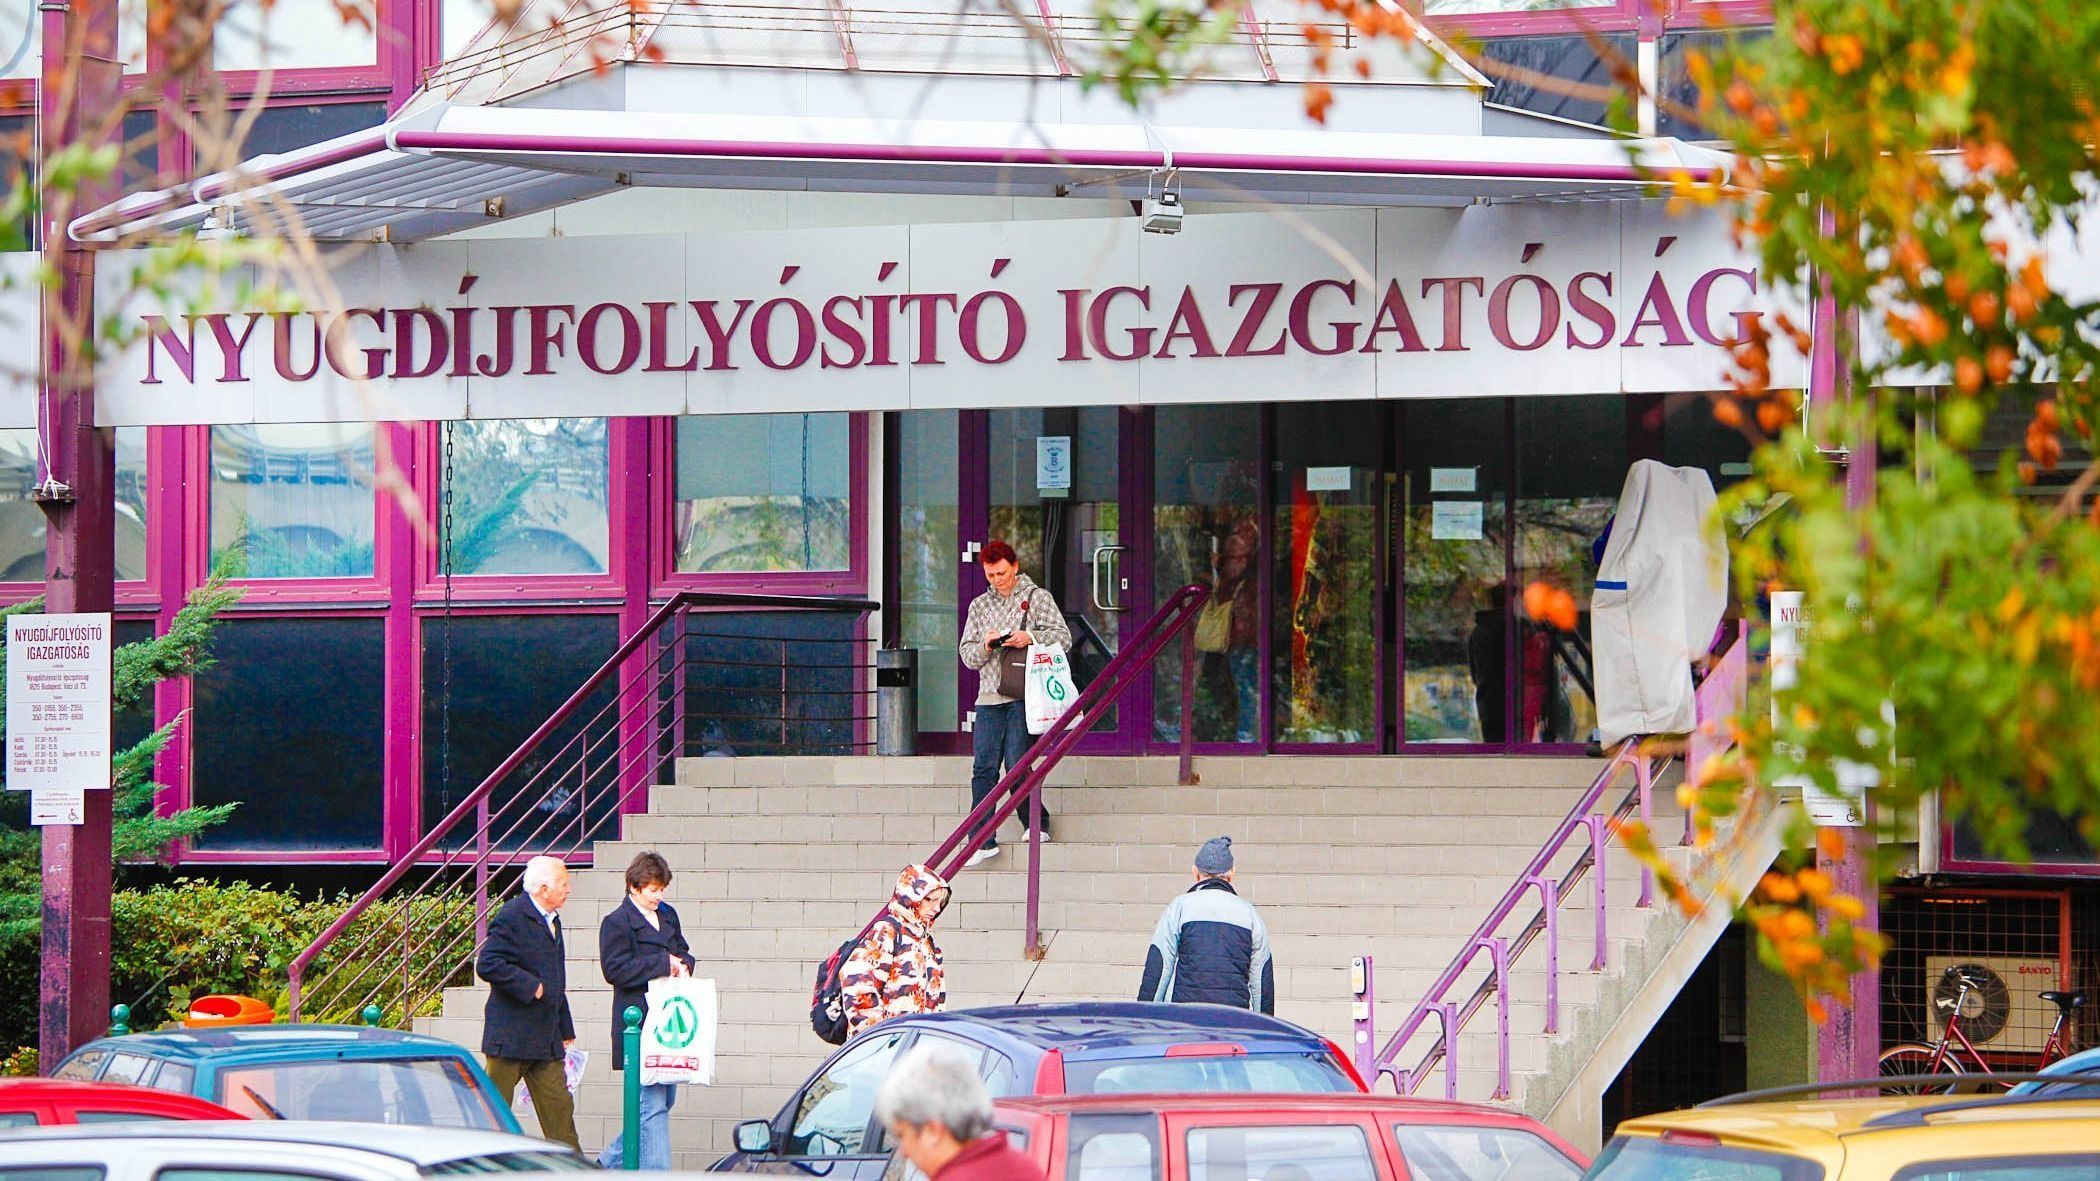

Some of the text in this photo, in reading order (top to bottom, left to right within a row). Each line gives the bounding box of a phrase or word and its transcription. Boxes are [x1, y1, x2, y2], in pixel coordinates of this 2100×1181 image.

[140, 235, 1764, 384] NYUGDÍJFOLYÓSÍTÓ IGAZGATÓSÁG
[15, 624, 102, 642] NYUGDÍJFOLYÓSÍTÓ
[27, 642, 90, 660] IGAZGATÓSÁG
[2018, 966, 2052, 975] SANYO
[644, 1054, 700, 1071] SPAR
